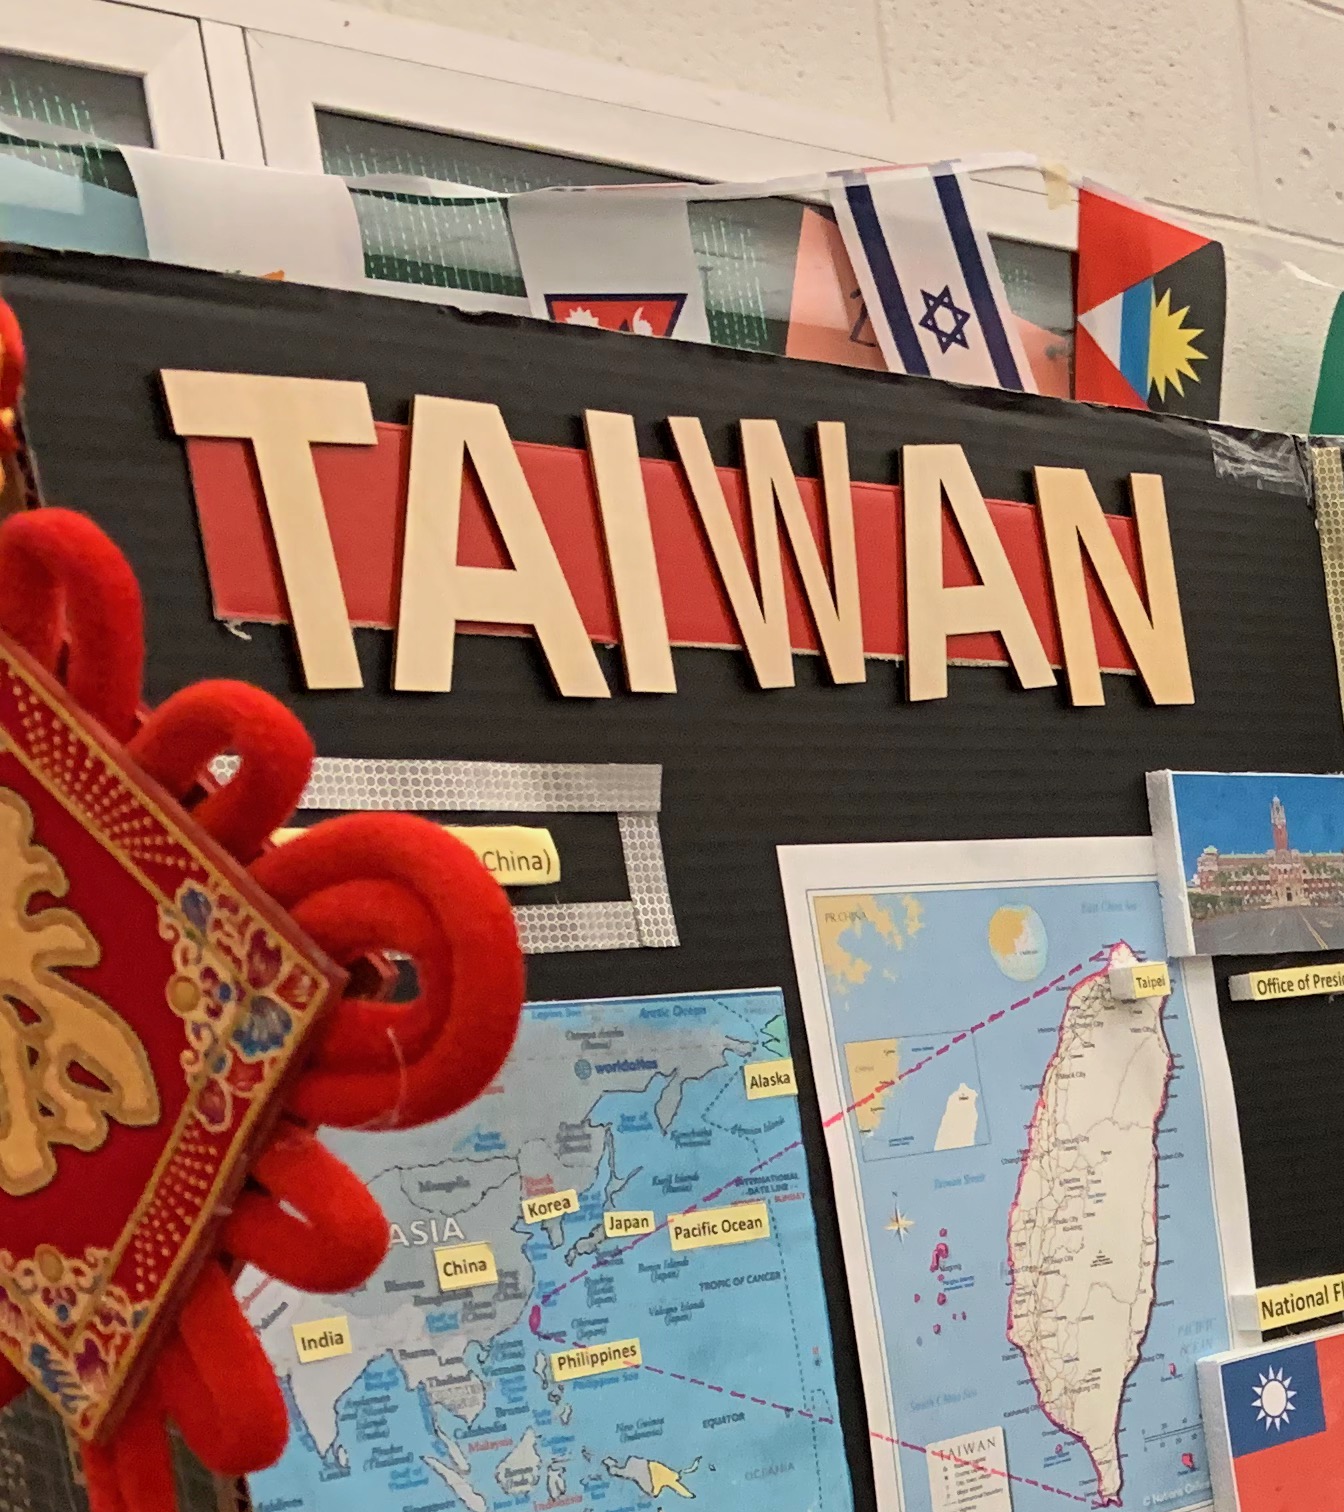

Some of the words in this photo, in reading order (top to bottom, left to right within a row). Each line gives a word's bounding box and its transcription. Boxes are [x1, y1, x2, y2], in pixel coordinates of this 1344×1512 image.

[160, 368, 1195, 707] TAIWAN
[482, 848, 551, 876] China)
[1135, 976, 1166, 991] Taipei
[1257, 976, 1294, 996] Office
[1297, 974, 1312, 990] of
[750, 1072, 791, 1090] Alaska
[527, 1196, 572, 1218] Korea
[389, 1217, 465, 1247] ASIA
[608, 1215, 650, 1232] Japan
[674, 1221, 719, 1241] Pacific
[721, 1216, 763, 1233] Ocean
[443, 1258, 488, 1277] China
[1262, 1287, 1330, 1320] National
[300, 1330, 345, 1352] India
[556, 1343, 637, 1371] Philippines
